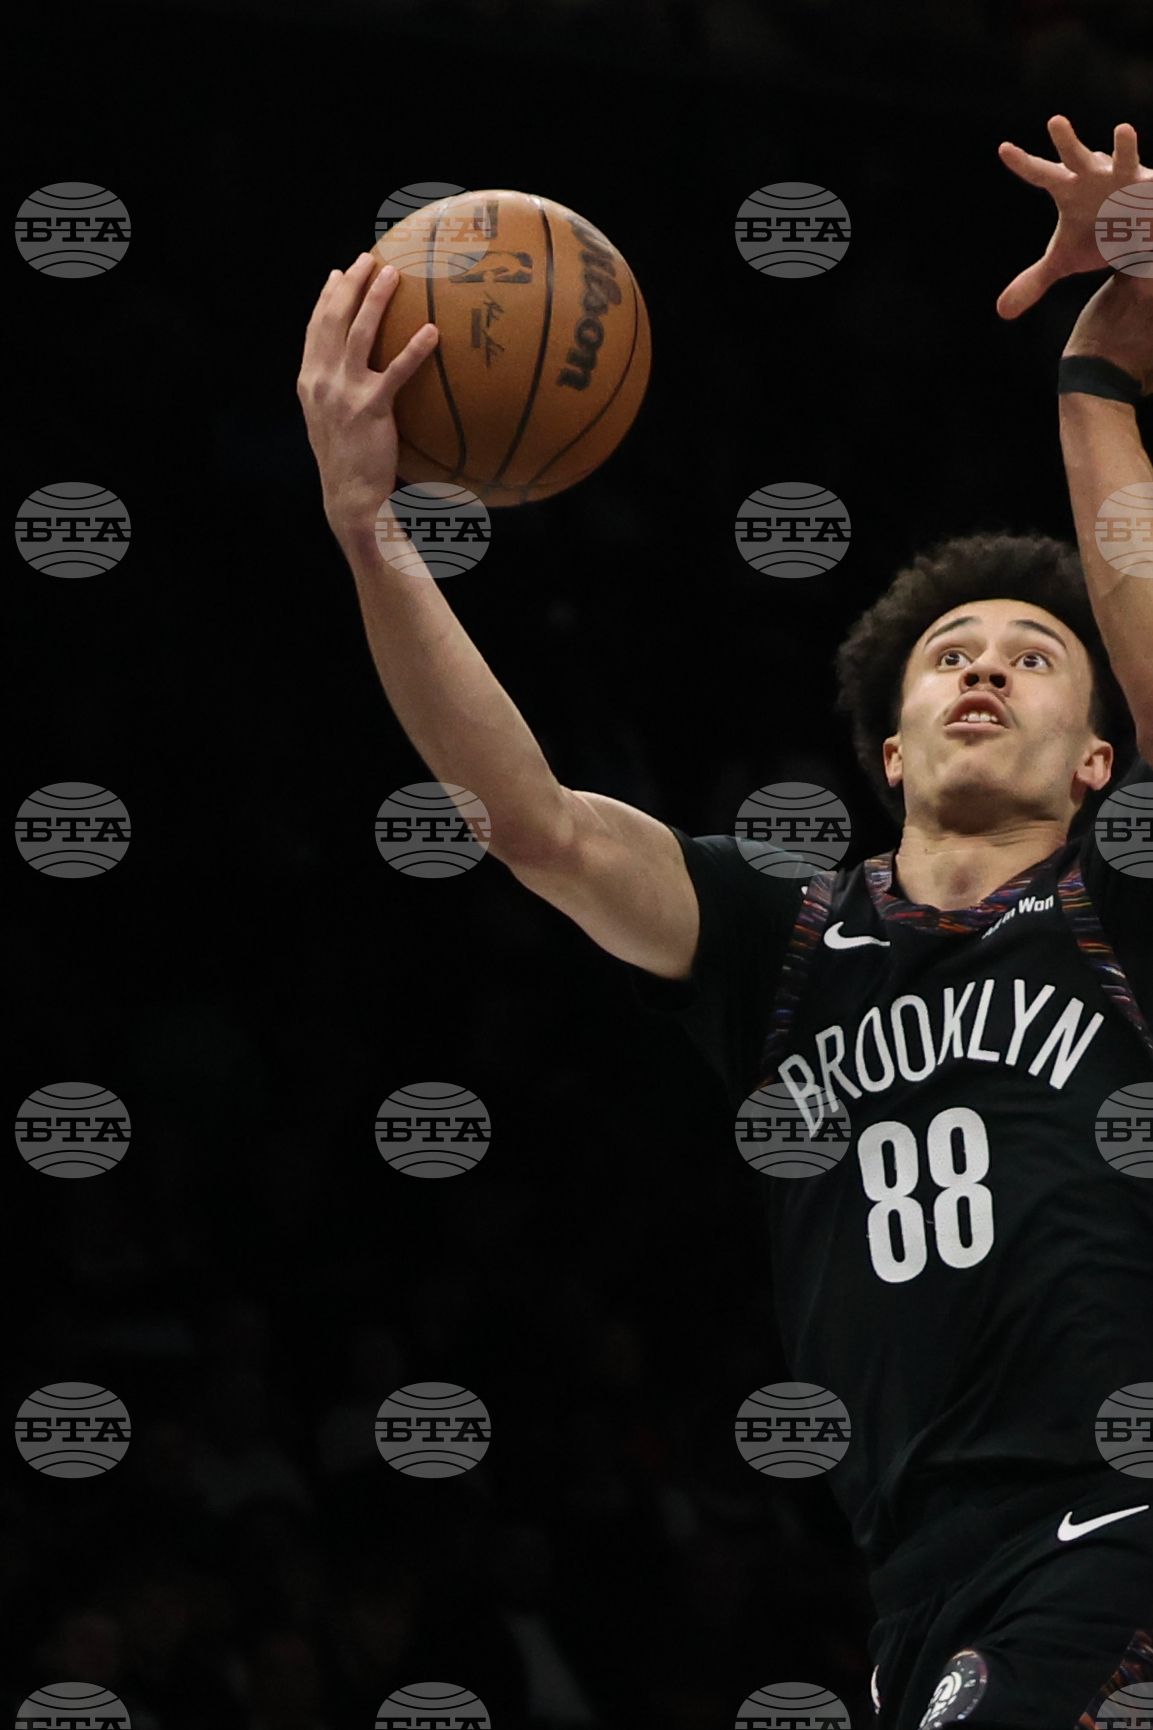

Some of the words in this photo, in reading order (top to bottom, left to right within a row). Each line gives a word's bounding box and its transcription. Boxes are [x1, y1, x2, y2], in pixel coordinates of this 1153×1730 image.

[1018, 894, 1055, 914] Won
[777, 978, 1105, 1138] BROOKLYN
[857, 1106, 995, 1284] 88
